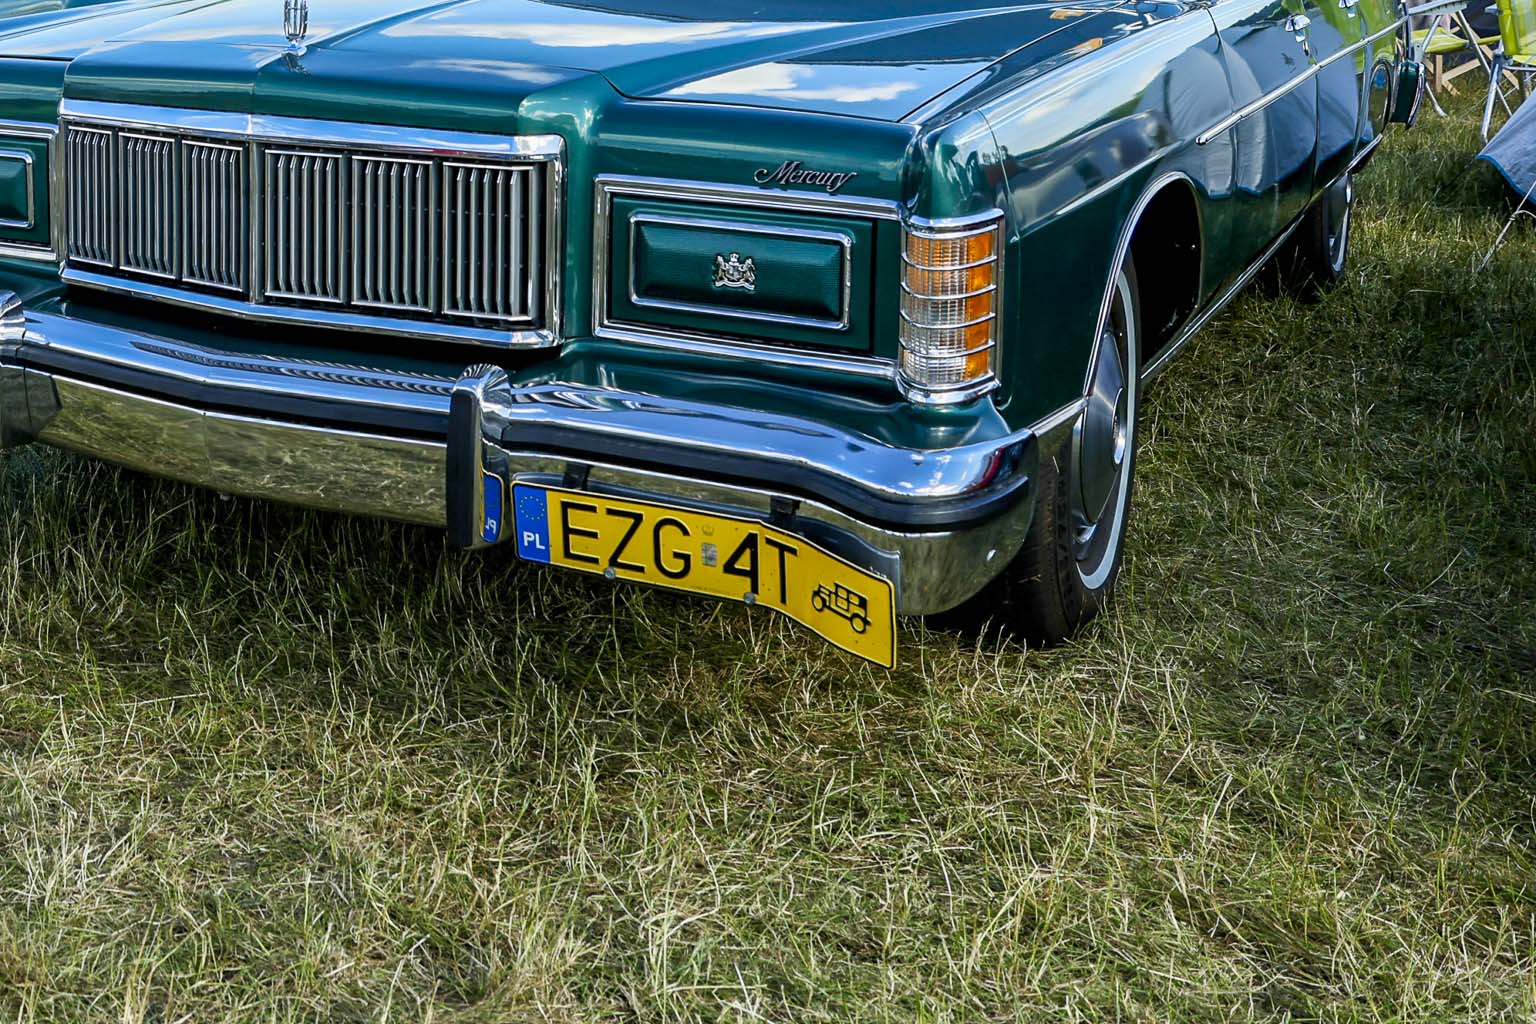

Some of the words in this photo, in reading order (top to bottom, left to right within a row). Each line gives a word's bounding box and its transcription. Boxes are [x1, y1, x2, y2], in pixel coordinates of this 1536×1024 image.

[753, 160, 858, 192] Mercury
[523, 530, 545, 550] PL
[560, 499, 692, 579] EZG
[722, 530, 798, 606] 4T
